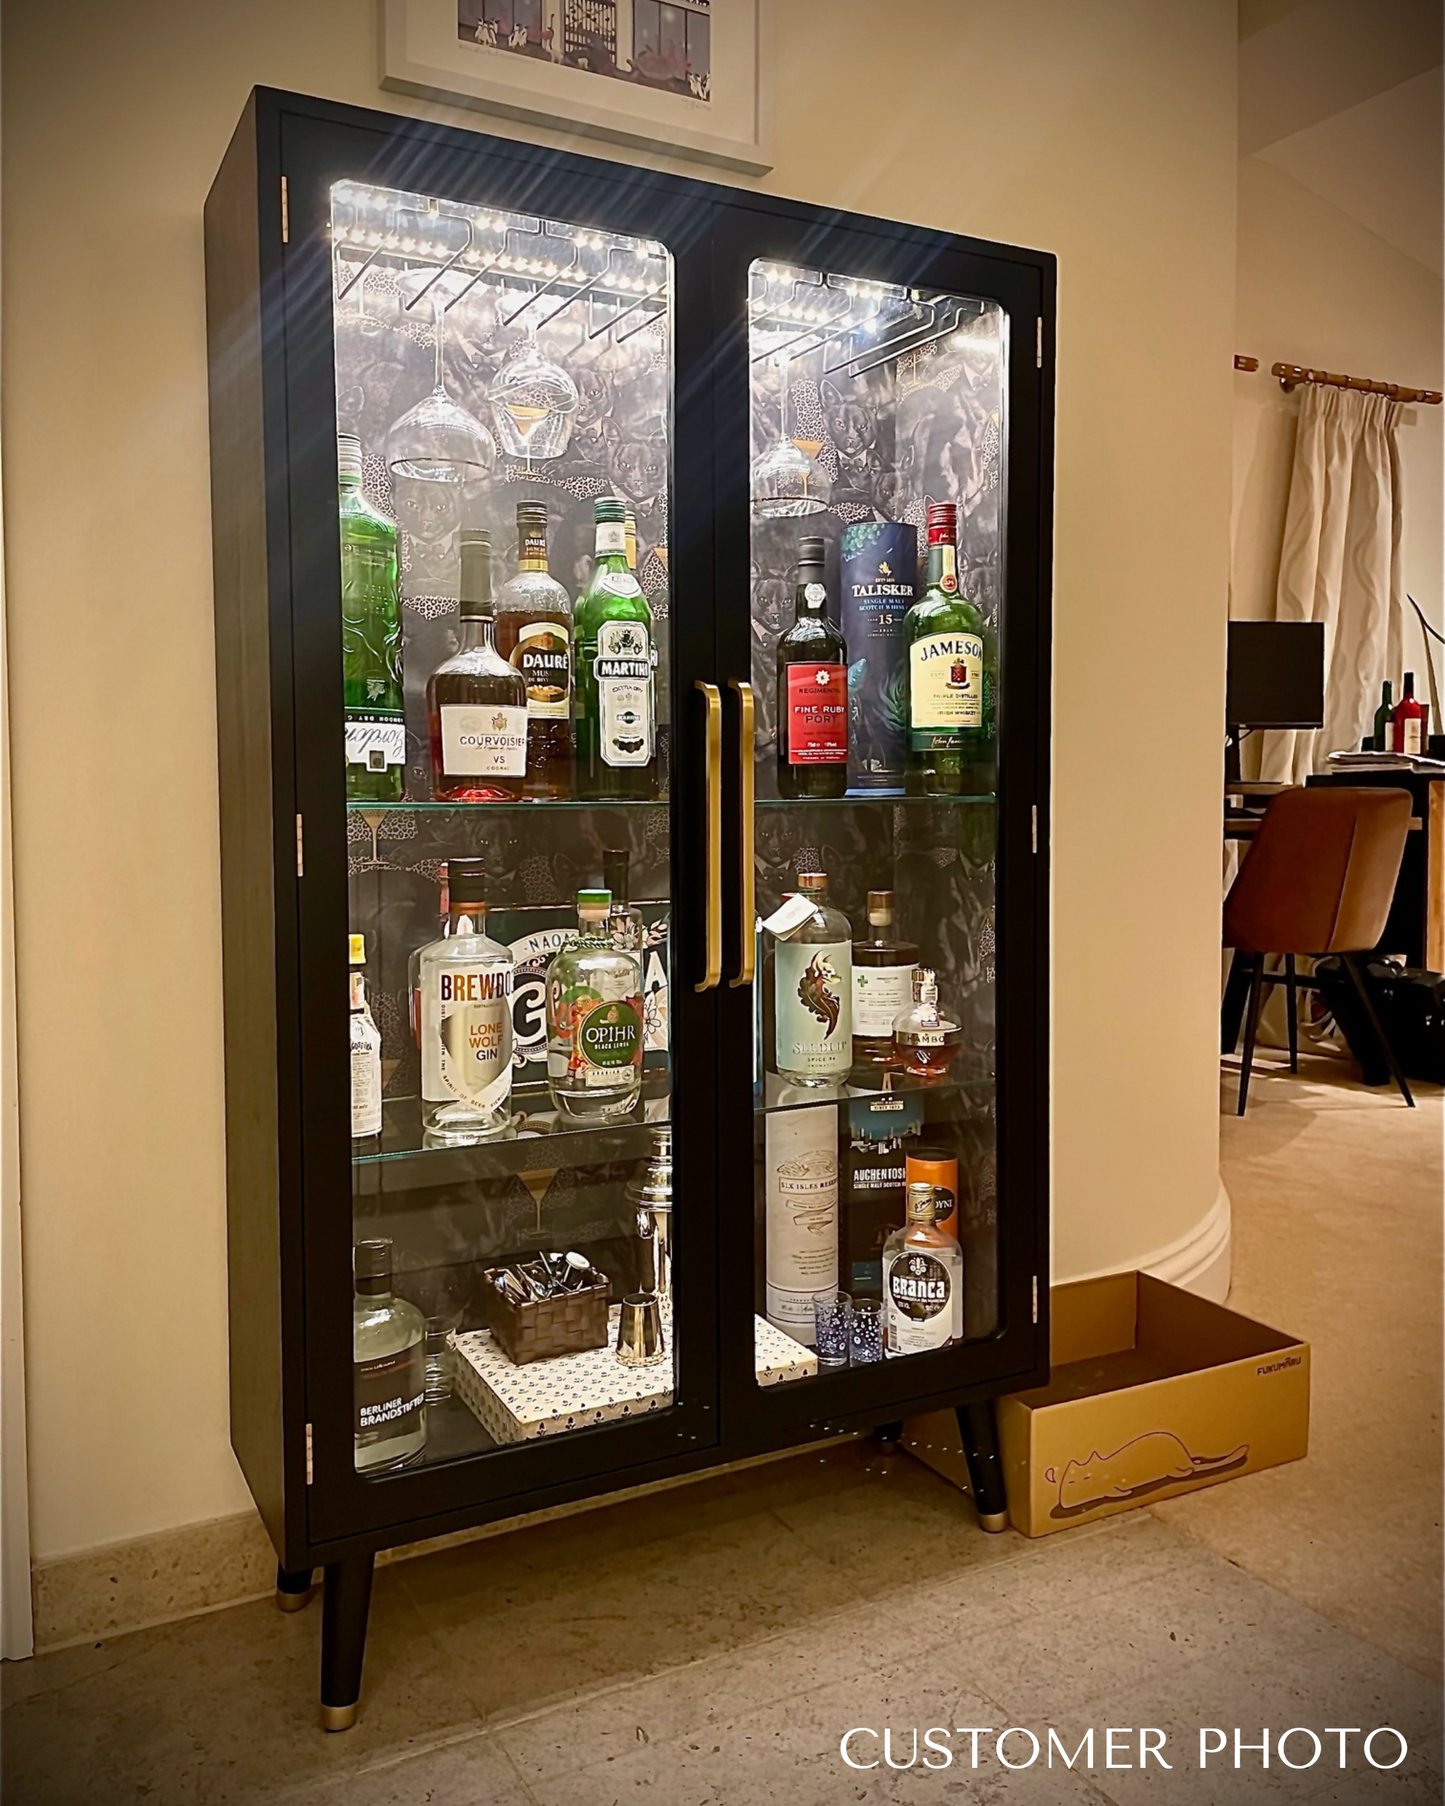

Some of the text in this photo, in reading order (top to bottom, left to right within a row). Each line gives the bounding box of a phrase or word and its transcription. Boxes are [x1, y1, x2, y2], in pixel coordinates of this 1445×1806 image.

[851, 584, 914, 597] TALISKER
[878, 614, 893, 625] 15
[523, 652, 568, 670] DAURÉ
[600, 661, 649, 677] MARTINI
[794, 705, 845, 714] FINE RUBY
[805, 715, 837, 724] PORT
[493, 755, 506, 764] VS
[441, 971, 512, 1001] BREWDO
[470, 1022, 503, 1036] LONE
[585, 1025, 636, 1043] OPIHR
[469, 1034, 503, 1049] WOLF
[476, 1048, 498, 1061] GIN
[442, 1075, 458, 1093] SPIRIT
[459, 1092, 467, 1100] OF
[470, 1100, 486, 1109] BEER
[796, 1182, 818, 1190] ISLES
[360, 1397, 402, 1416] BERLINER
[360, 1392, 424, 1427] BRANDSTIFTER
